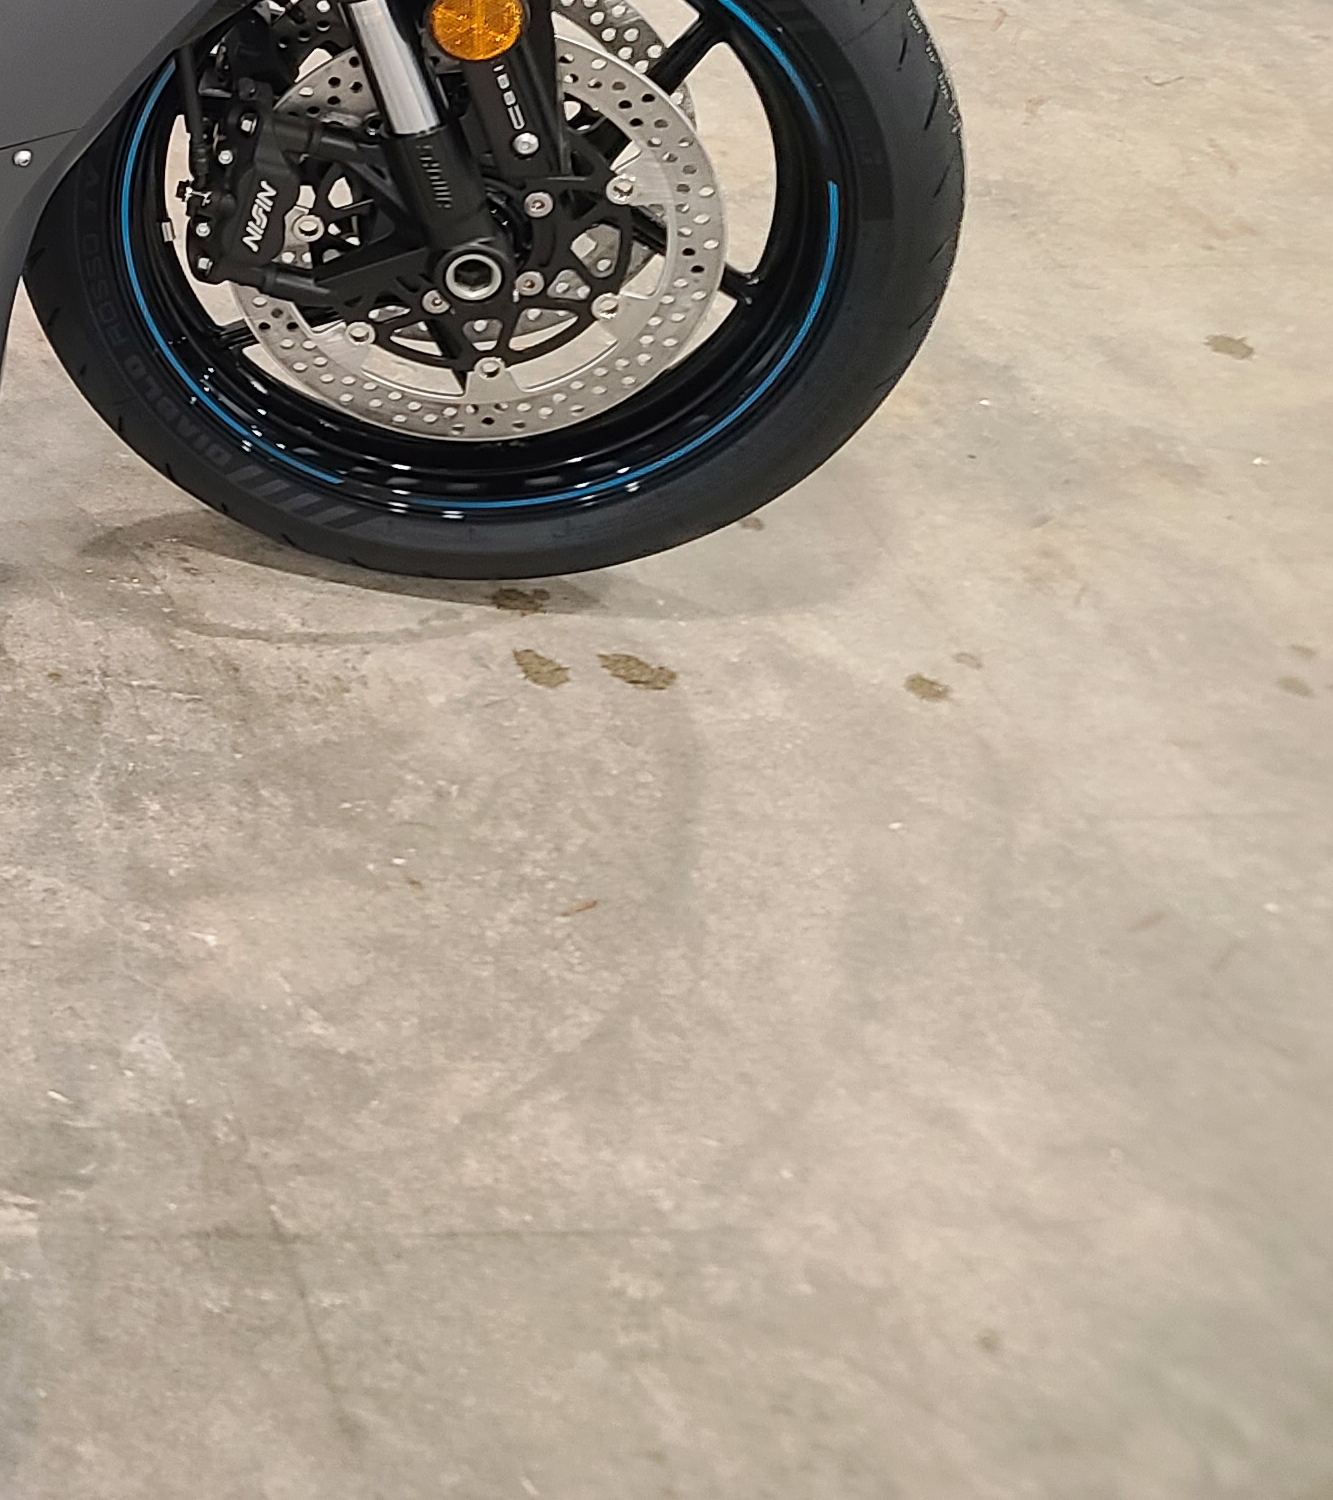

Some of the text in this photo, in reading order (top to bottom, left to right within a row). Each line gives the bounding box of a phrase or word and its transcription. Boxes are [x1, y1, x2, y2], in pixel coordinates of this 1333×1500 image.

[242, 180, 277, 252] NISSIN
[79, 234, 130, 344] ROSSO
[124, 354, 234, 468] DIABLO
